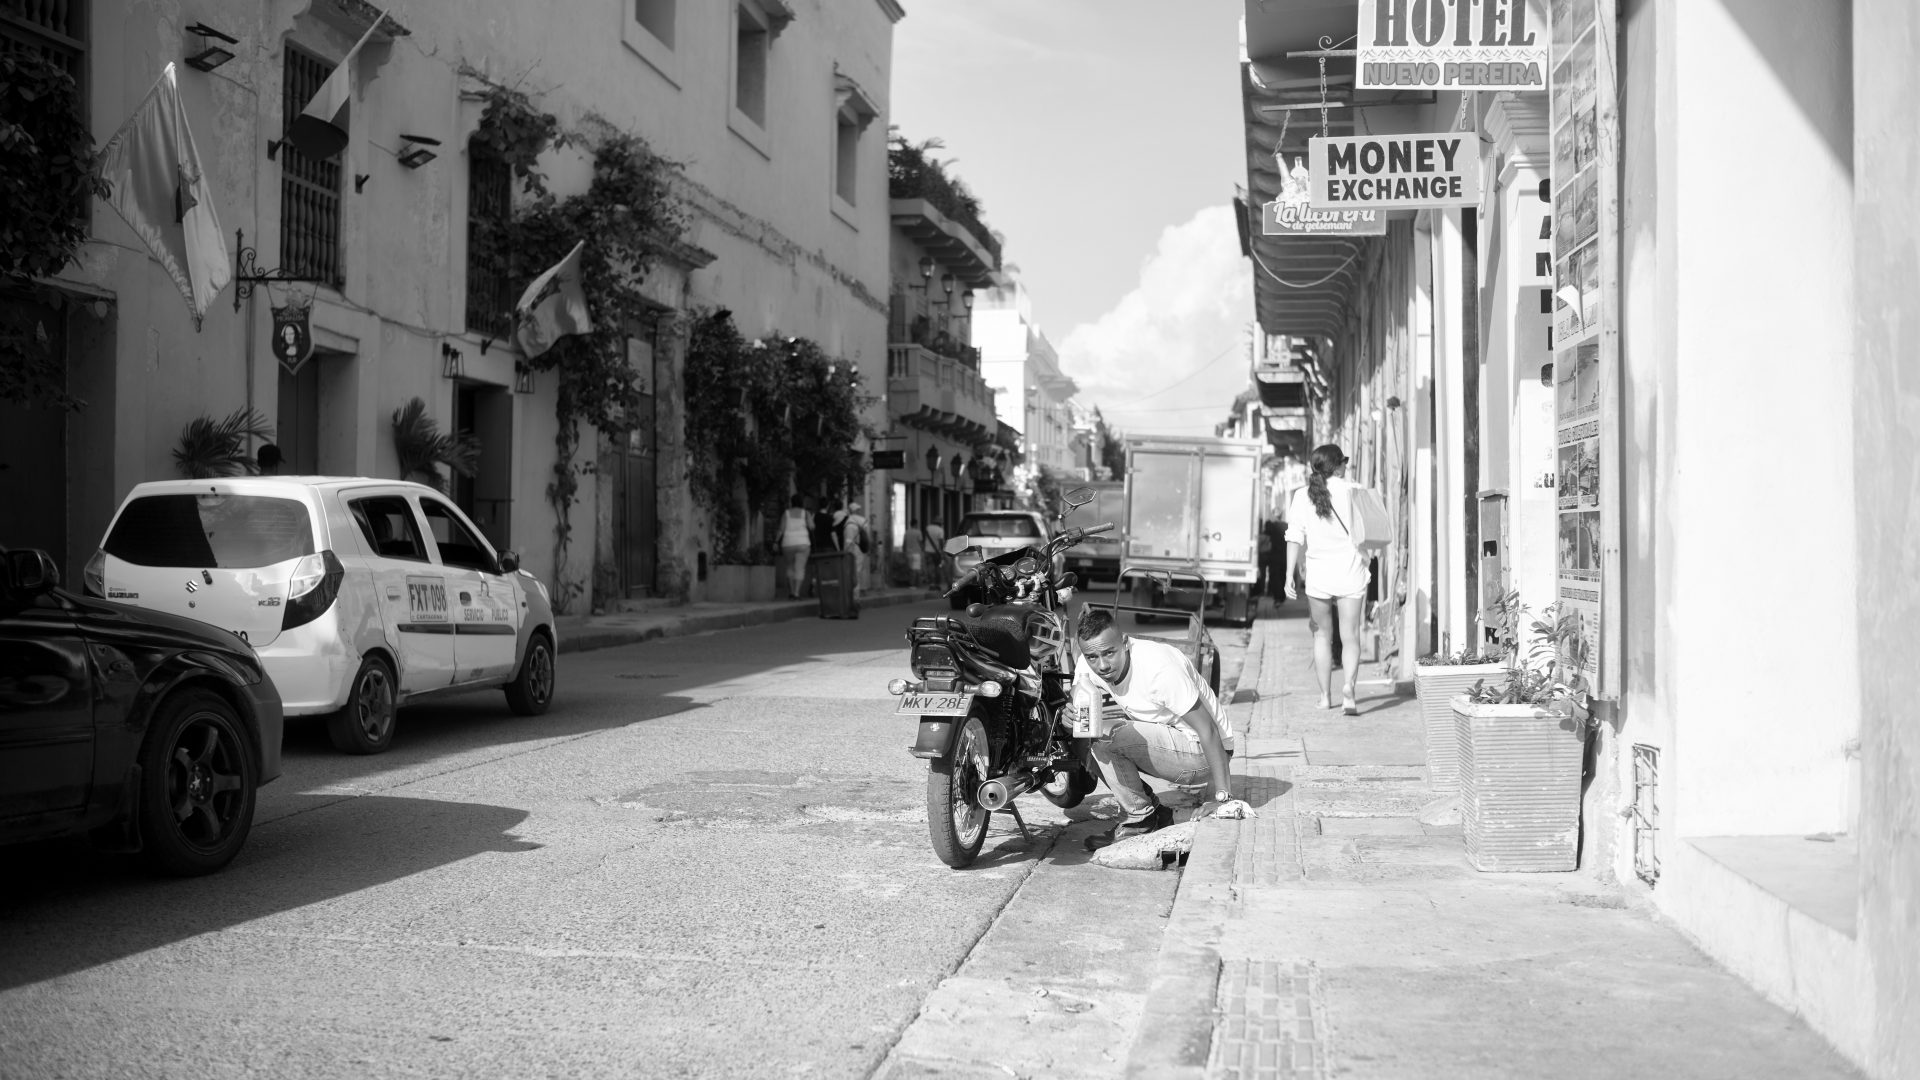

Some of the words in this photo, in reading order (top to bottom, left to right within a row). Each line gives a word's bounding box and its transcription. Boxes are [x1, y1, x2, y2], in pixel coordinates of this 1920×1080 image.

[1373, 0, 1536, 47] HOTEL
[1363, 62, 1440, 86] NUEVO
[1443, 62, 1543, 86] PEREIRA
[1327, 139, 1462, 176] MONEY
[1327, 176, 1463, 202] EXCHANGE
[1273, 201, 1297, 229] La
[408, 583, 428, 612] FXT
[430, 583, 447, 612] 098
[901, 697, 933, 709] MKV
[936, 697, 968, 710] 28E
